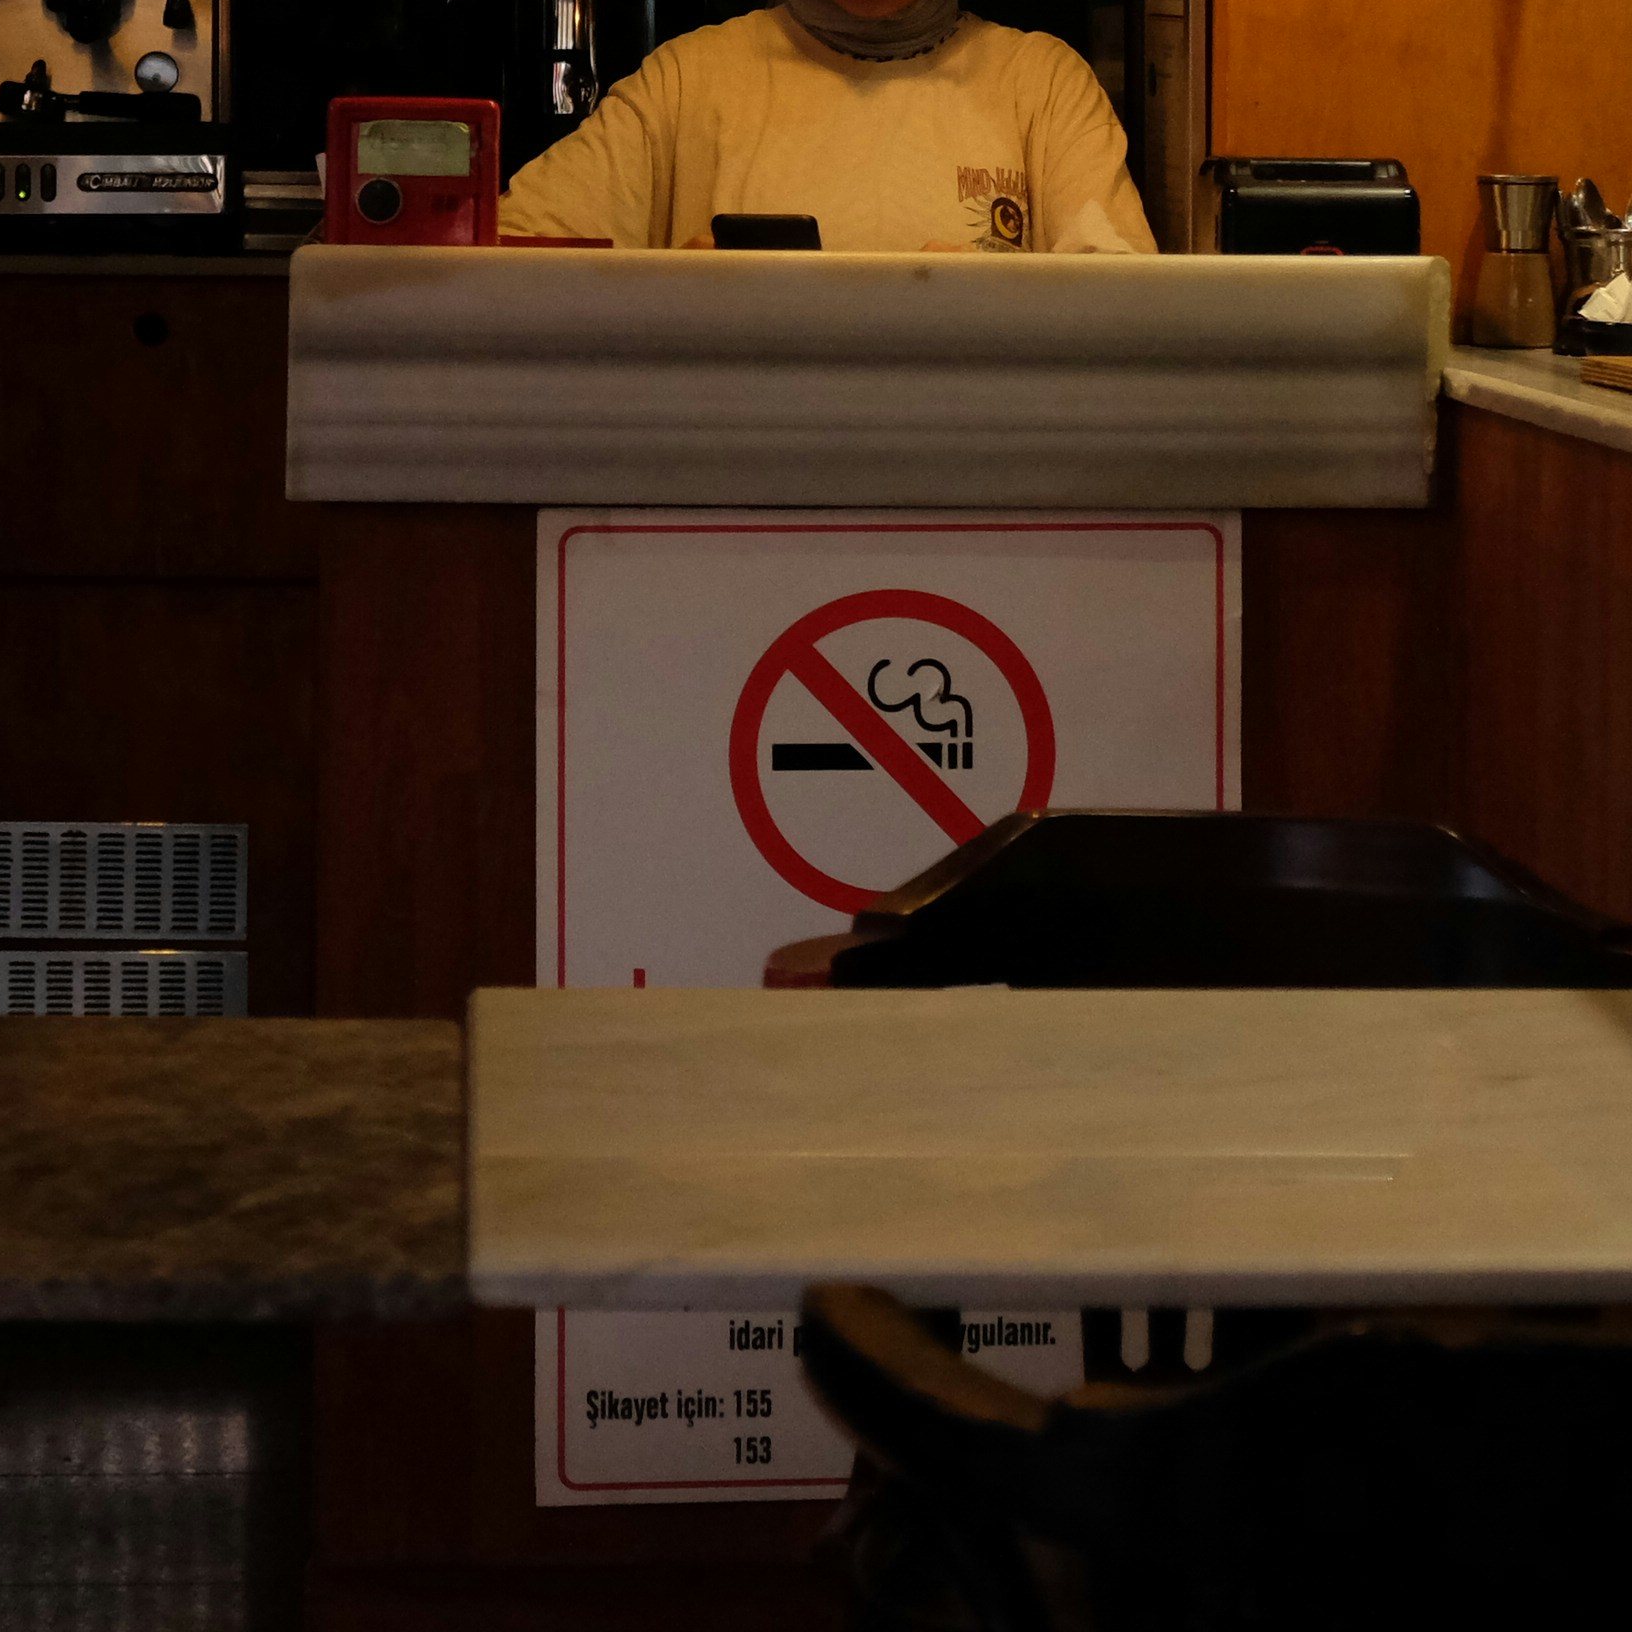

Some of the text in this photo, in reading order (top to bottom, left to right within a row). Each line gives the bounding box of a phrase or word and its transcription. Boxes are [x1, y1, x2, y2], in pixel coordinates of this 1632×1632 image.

[729, 1319, 783, 1351] idari
[586, 1388, 773, 1429] Şikayet için: 155
[733, 1435, 773, 1466] 153
